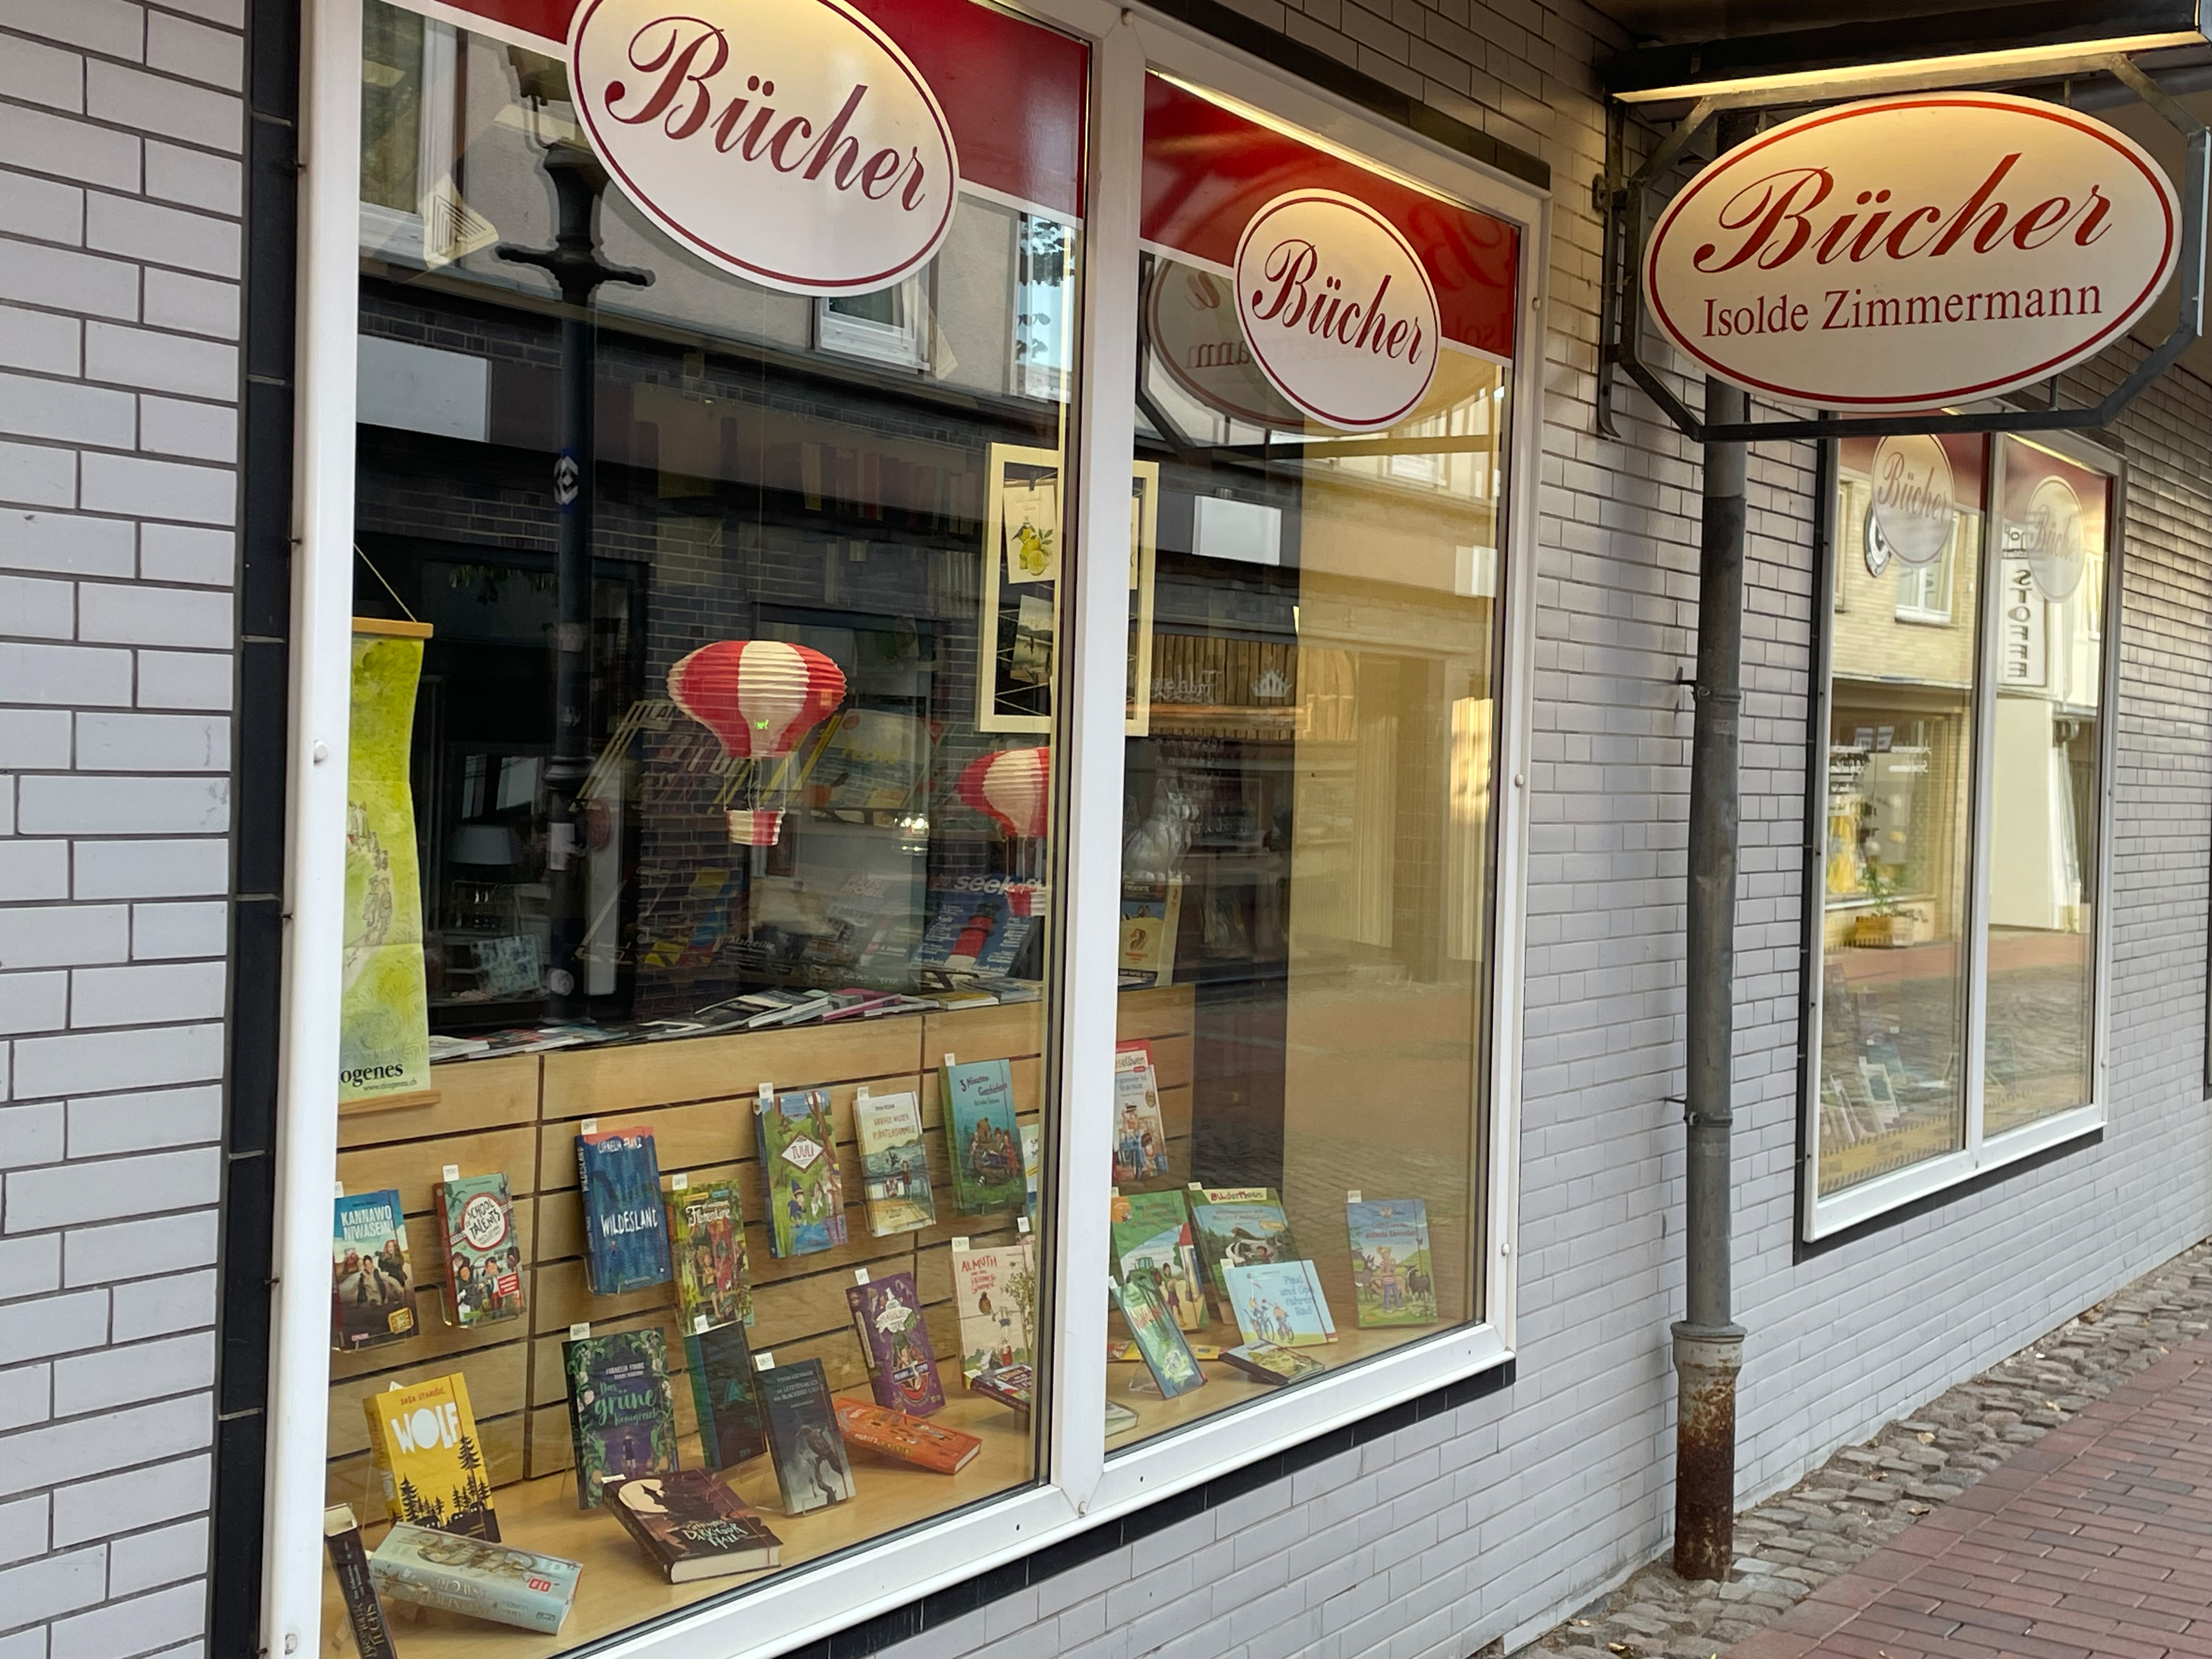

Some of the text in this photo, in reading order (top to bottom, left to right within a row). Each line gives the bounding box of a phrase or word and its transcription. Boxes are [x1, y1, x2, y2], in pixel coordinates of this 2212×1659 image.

[604, 16, 926, 211] Bücher
[1693, 152, 2113, 273] Bücher
[1251, 239, 1422, 364] Bücher
[1702, 284, 2102, 337] Isolde Zimmermann
[1878, 451, 1947, 523] Bücher
[340, 1063, 403, 1087] ogenes
[961, 1255, 997, 1272] ALMUTH
[391, 1401, 459, 1455] WOLF
[594, 1389, 658, 1427] grüne
